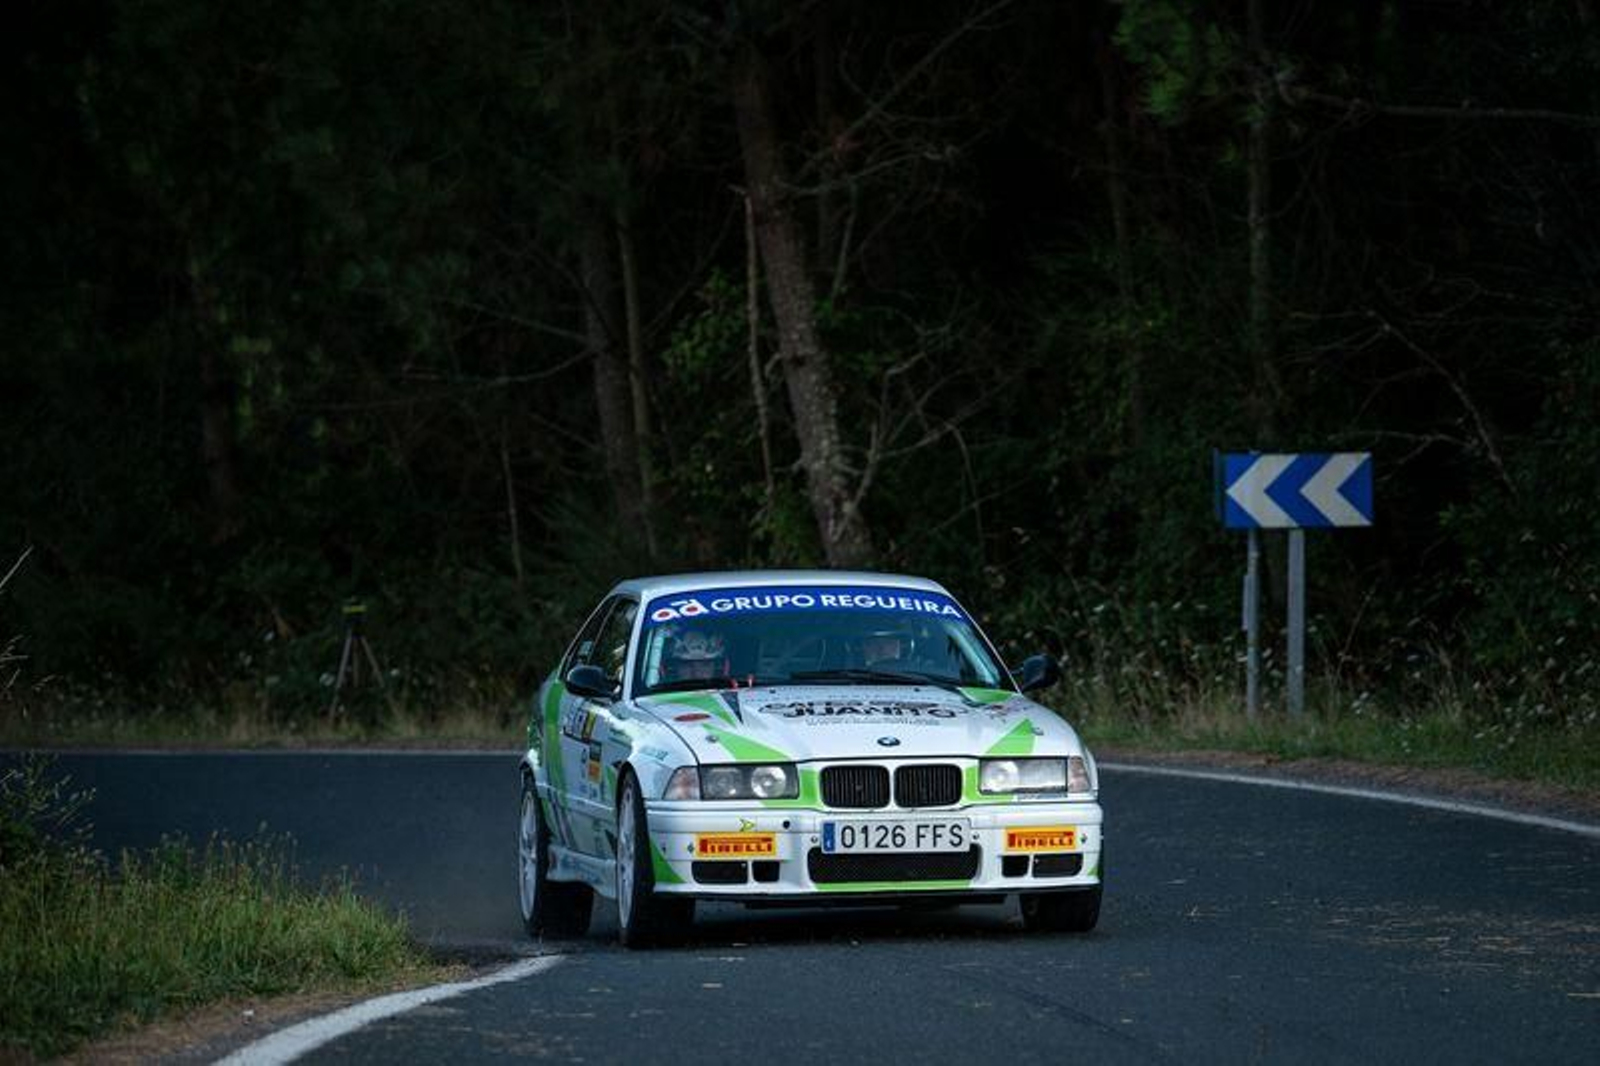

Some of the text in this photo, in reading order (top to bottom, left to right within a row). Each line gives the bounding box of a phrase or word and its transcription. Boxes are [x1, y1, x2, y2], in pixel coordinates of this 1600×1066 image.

[710, 595, 815, 612] GRUPO
[820, 594, 963, 619] REGUEIRA
[783, 706, 957, 718] JUANITO
[840, 823, 964, 849] 0126 FFS
[1007, 831, 1075, 848] PIRELLI
[697, 837, 773, 854] PIRELLI
